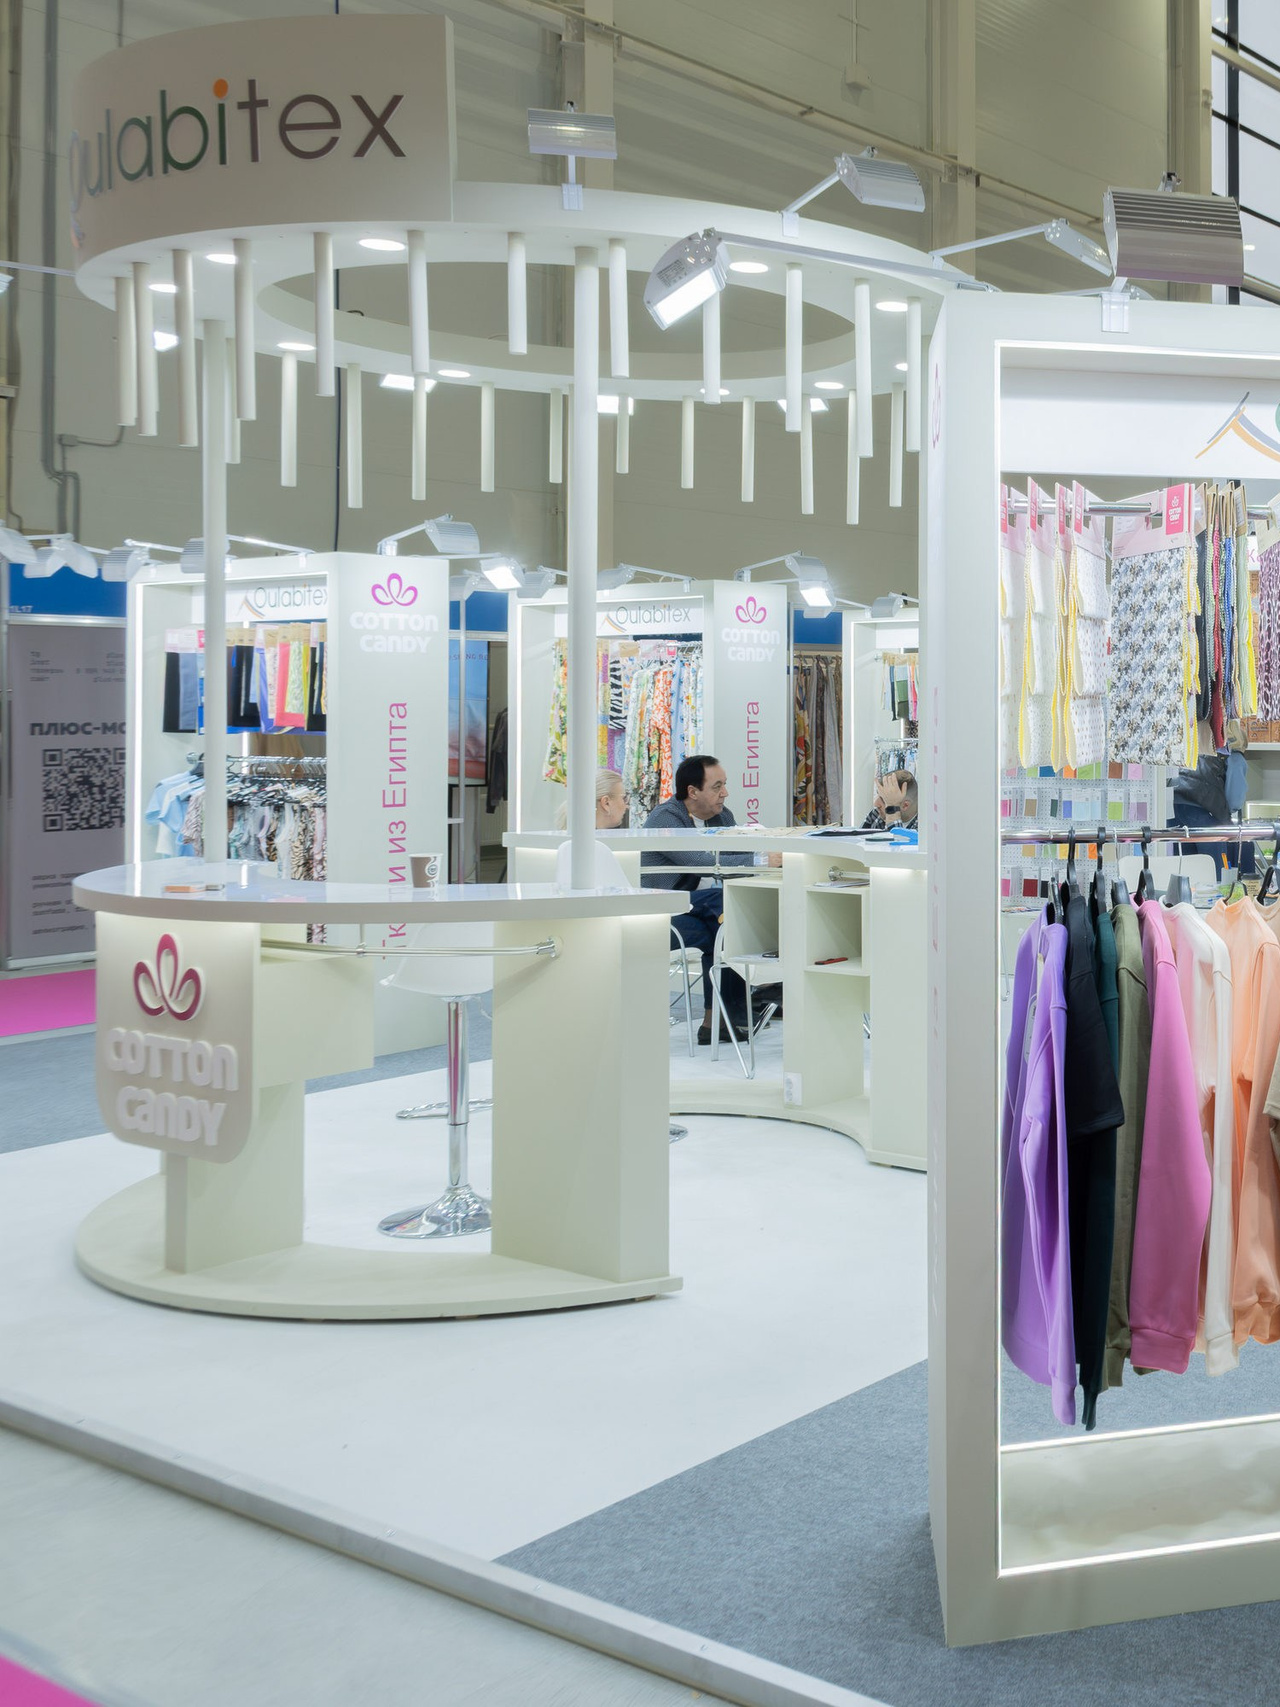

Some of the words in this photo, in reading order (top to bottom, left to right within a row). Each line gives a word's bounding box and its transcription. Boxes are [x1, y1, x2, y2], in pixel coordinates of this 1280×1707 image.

[70, 79, 406, 213] Oulabitex
[615, 604, 691, 625] Oulabitex
[382, 702, 407, 809] Египта
[742, 701, 760, 788] Египта
[388, 820, 406, 854] из
